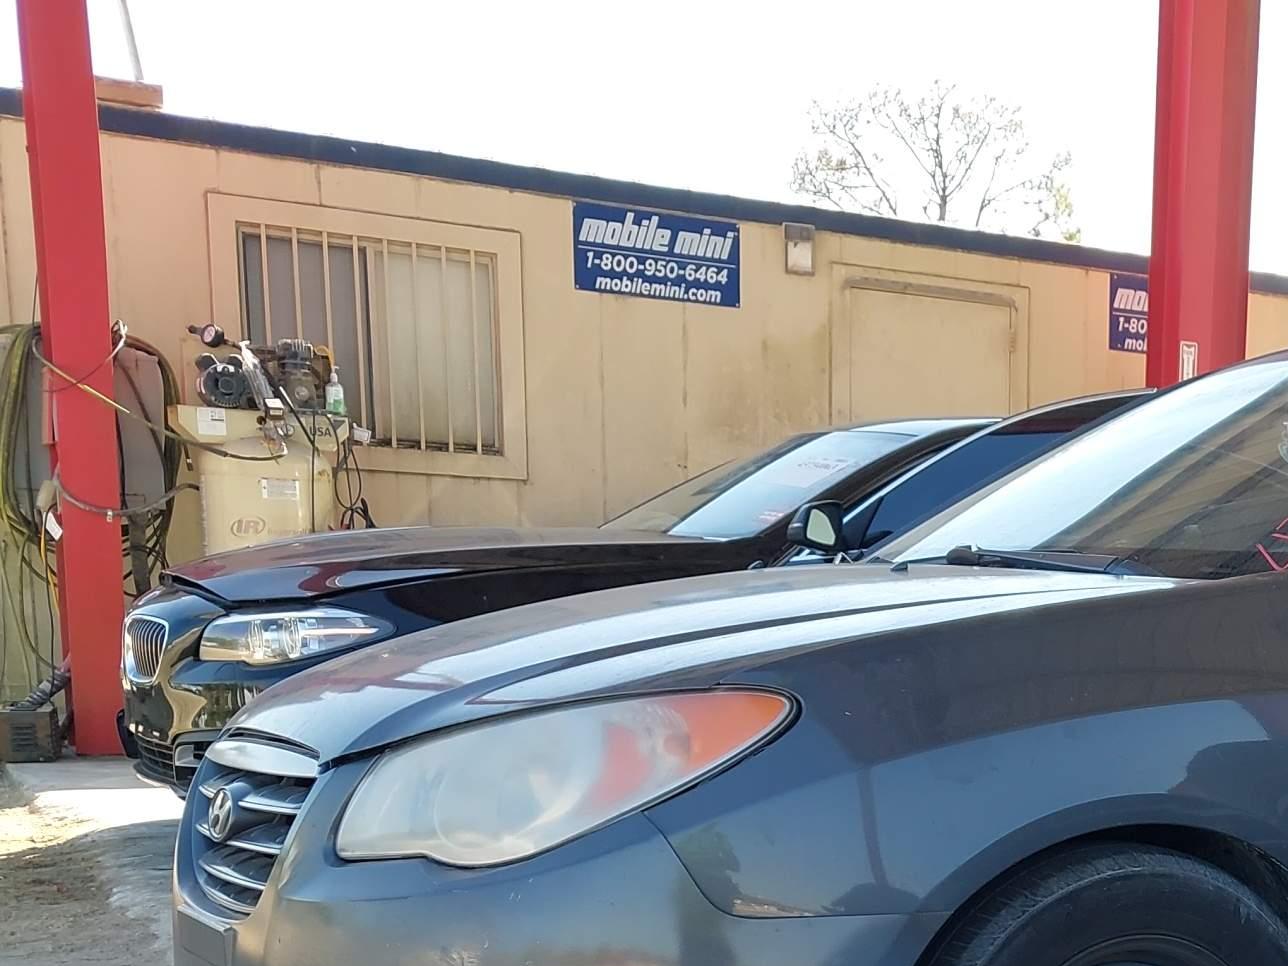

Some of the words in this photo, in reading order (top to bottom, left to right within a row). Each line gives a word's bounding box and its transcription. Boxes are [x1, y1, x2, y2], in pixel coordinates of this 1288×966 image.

[578, 212, 672, 252] mobile
[673, 228, 735, 260] mini
[586, 251, 728, 285] 1-800-950-6464
[595, 276, 722, 303] mobilemini.com
[309, 425, 332, 438] USA
